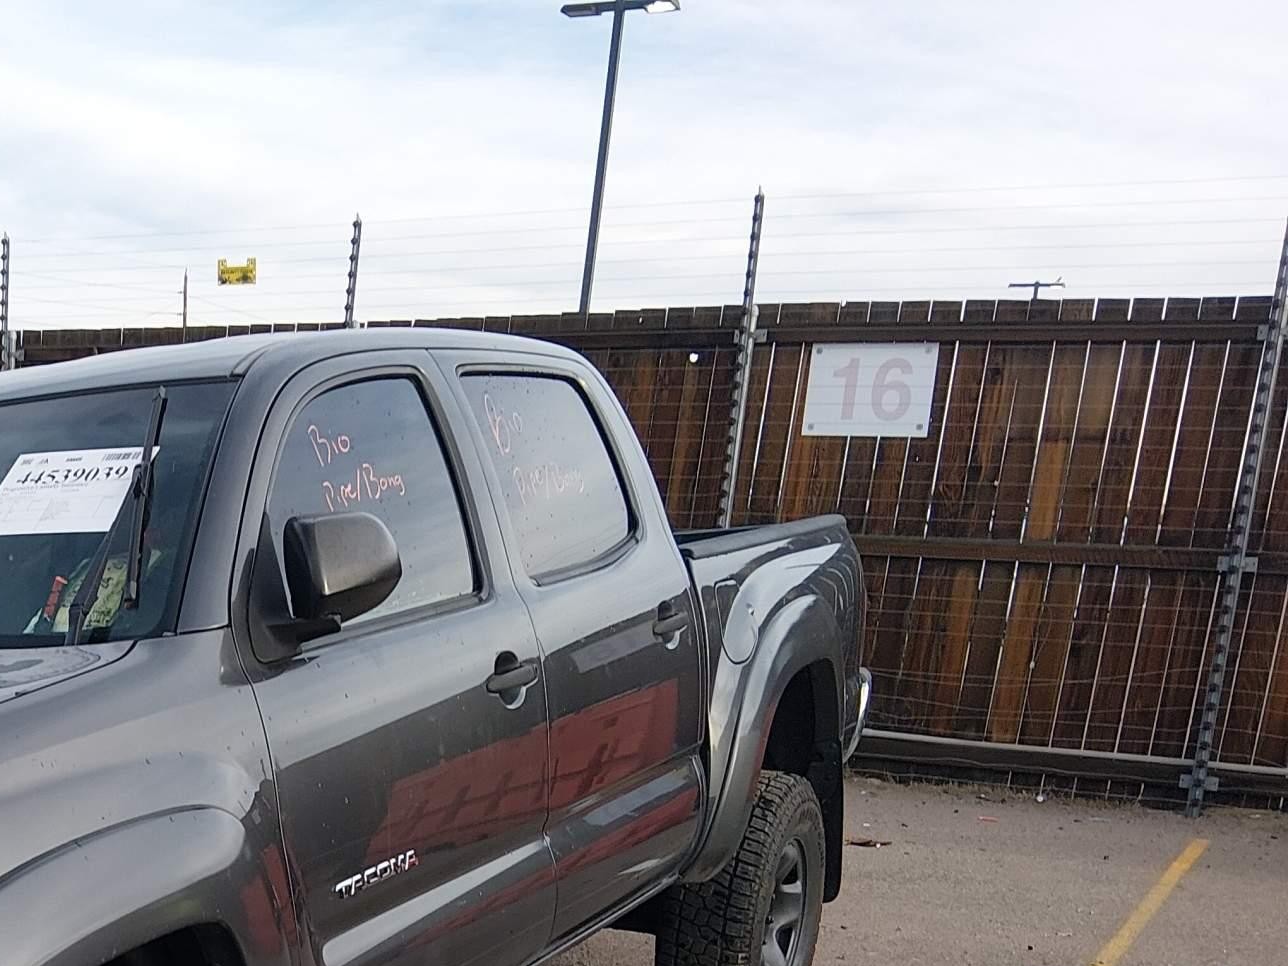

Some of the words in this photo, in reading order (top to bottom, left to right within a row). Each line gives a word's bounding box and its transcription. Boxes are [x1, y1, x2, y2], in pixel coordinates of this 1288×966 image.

[833, 357, 913, 421] 16
[307, 424, 350, 467] Bio
[16, 465, 130, 485] 44539039
[335, 849, 419, 899] TACOMA
